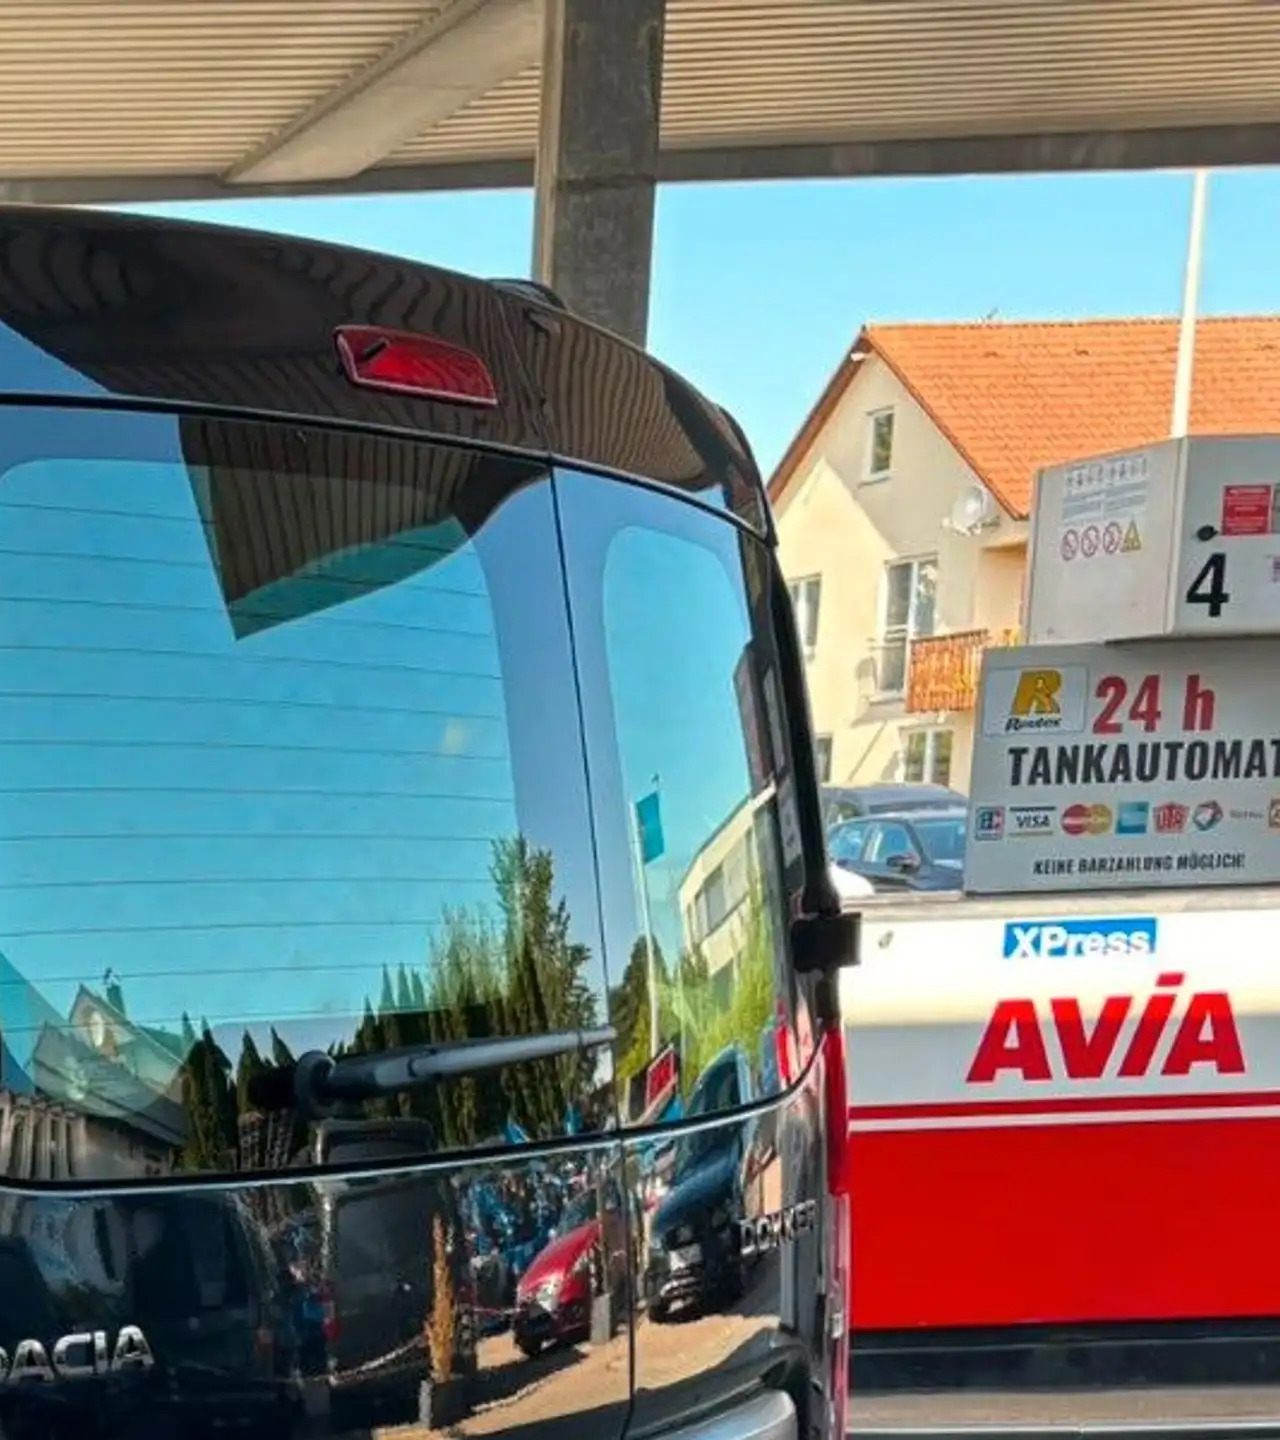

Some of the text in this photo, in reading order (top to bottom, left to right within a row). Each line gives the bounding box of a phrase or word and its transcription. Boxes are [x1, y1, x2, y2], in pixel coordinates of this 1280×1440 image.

[1186, 553, 1230, 617] 4
[1092, 673, 1217, 734] 24 h
[1008, 738, 1280, 786] TANKAUTOMAT
[1015, 813, 1050, 828] VISA
[1033, 858, 1073, 875] KEINE
[1078, 854, 1172, 873] BARZAHLUNG
[1008, 924, 1152, 958] XPress
